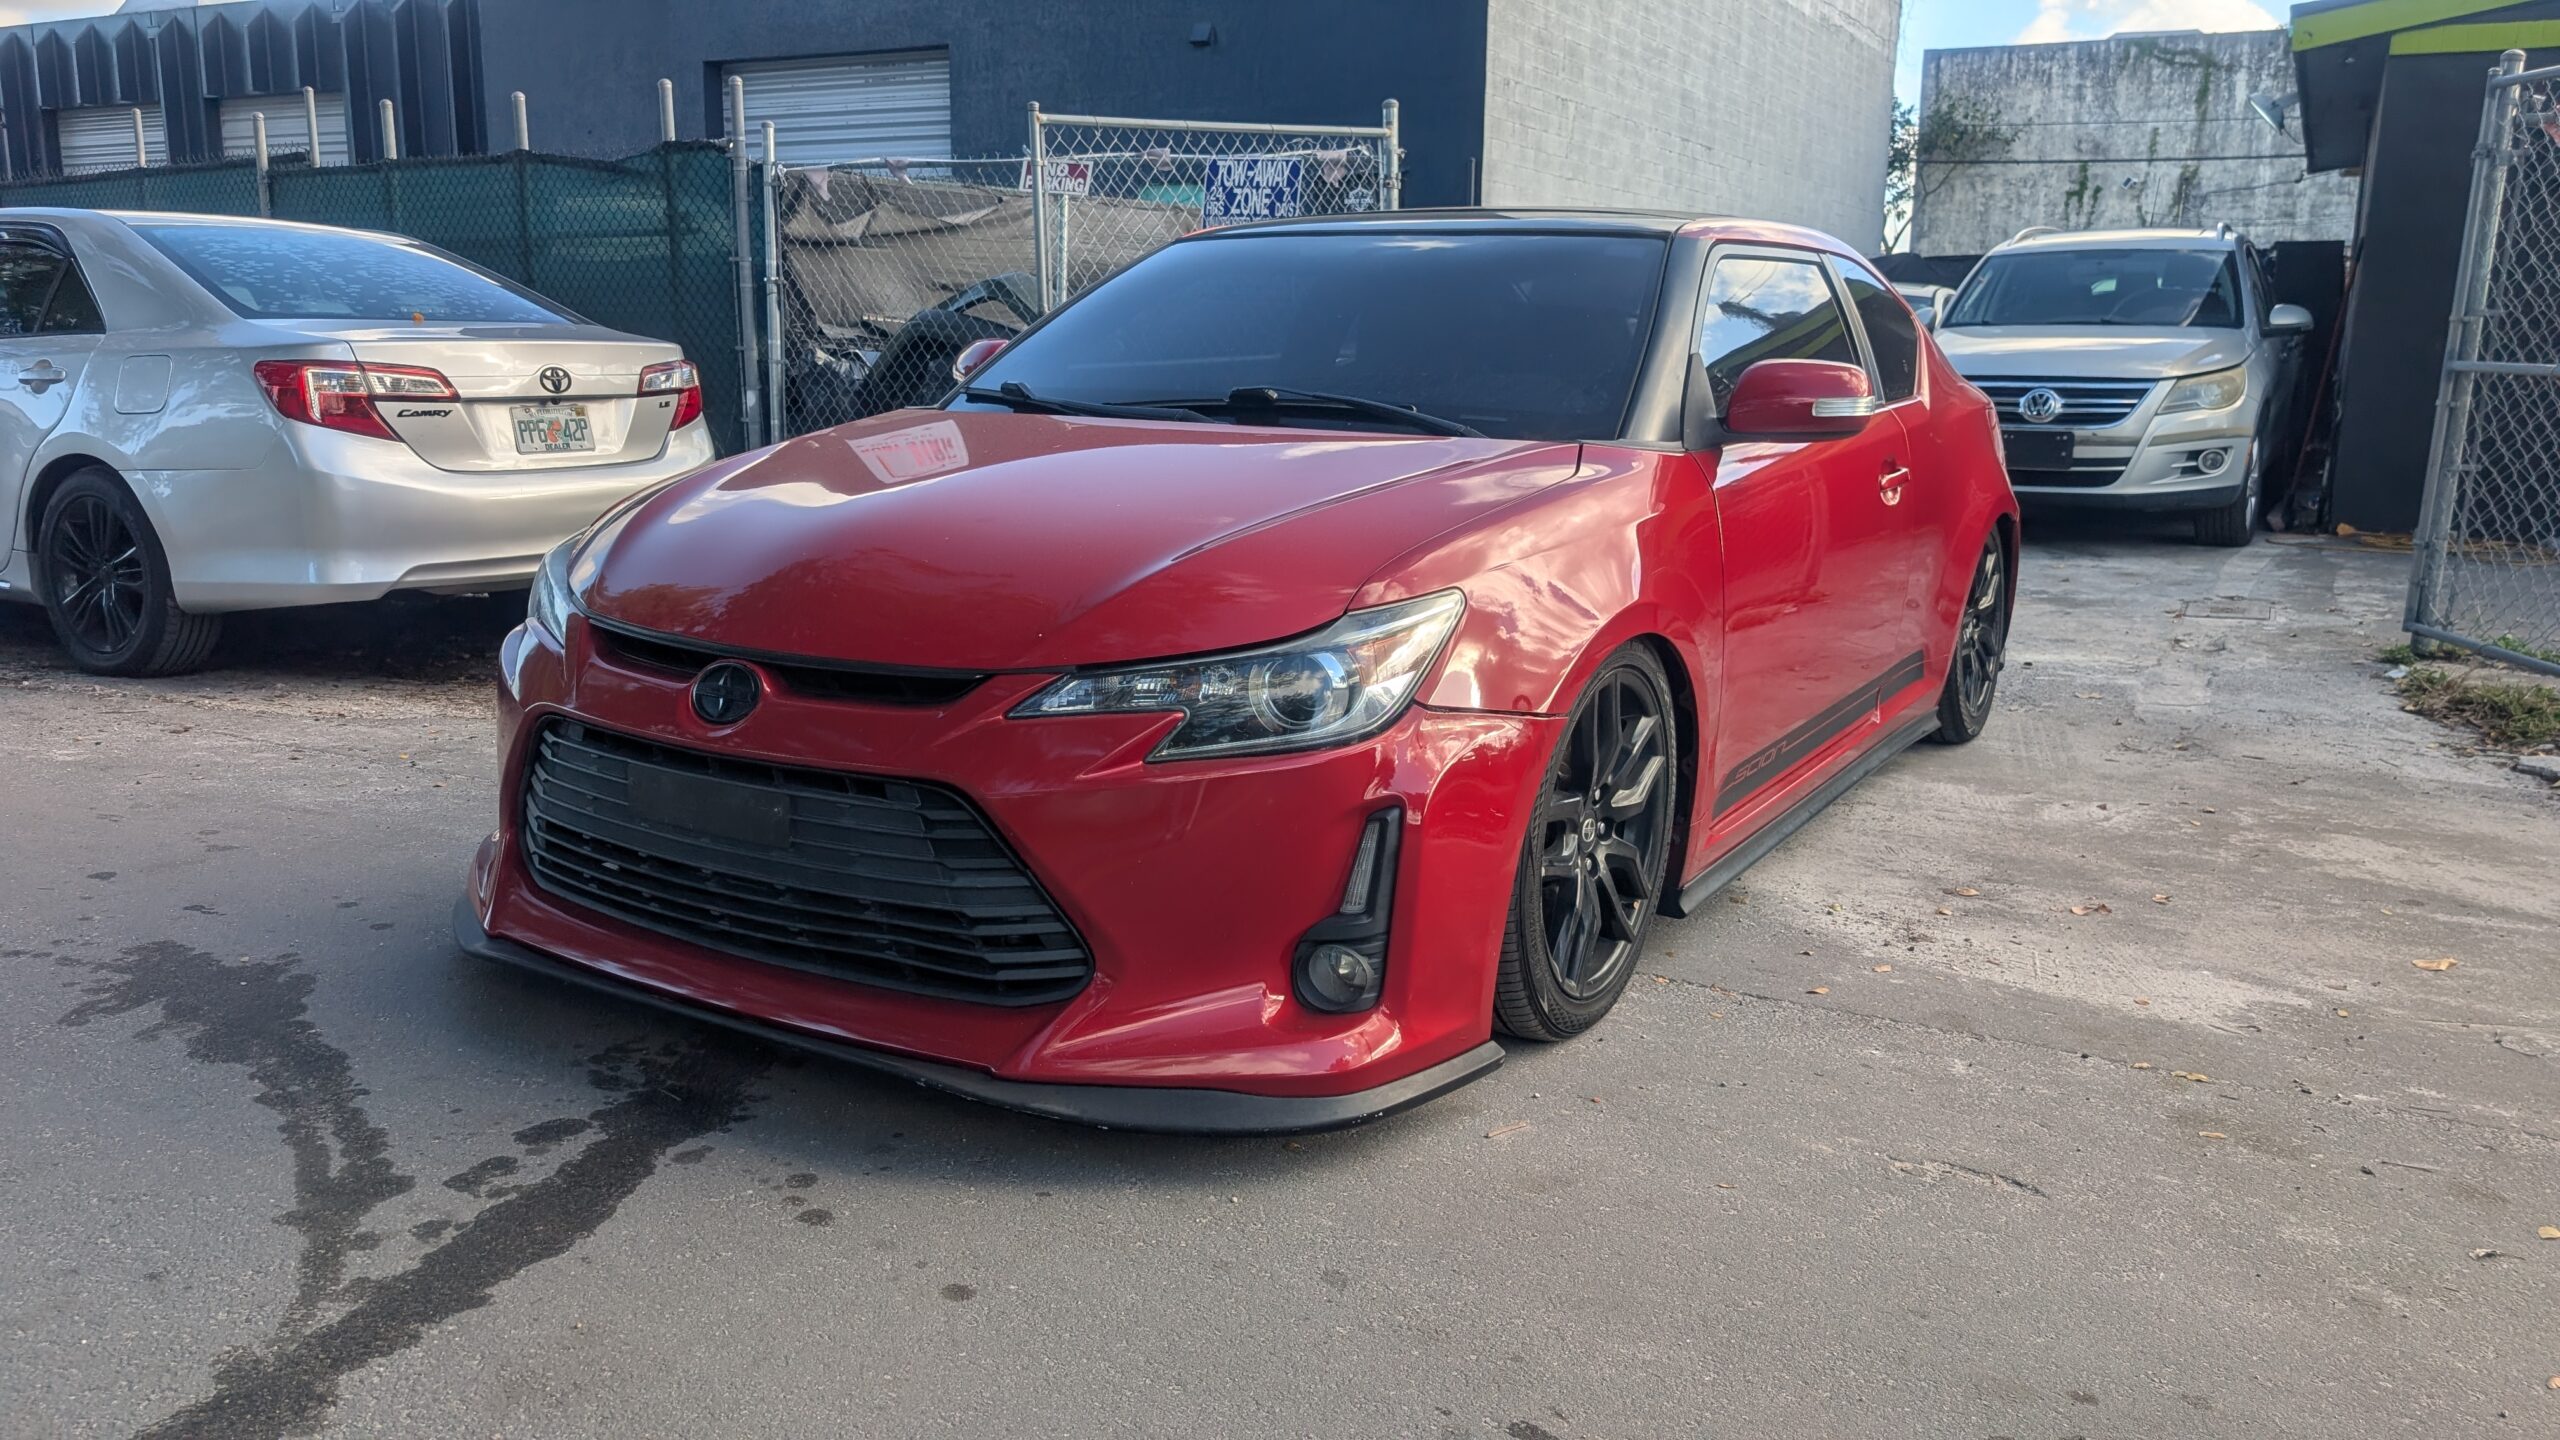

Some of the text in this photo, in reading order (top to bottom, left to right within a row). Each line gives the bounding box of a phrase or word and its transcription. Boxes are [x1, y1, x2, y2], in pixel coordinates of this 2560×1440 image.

[1046, 162, 1069, 177] NO
[1217, 160, 1292, 187] TOW-AWAY
[1025, 175, 1084, 192] PRKING
[1210, 186, 1223, 201] 24
[1230, 186, 1271, 216] ZONE
[1282, 187, 1290, 202] 7
[1275, 202, 1294, 217] DAYS
[563, 417, 588, 442] 42P
[544, 442, 571, 451] DEALER
